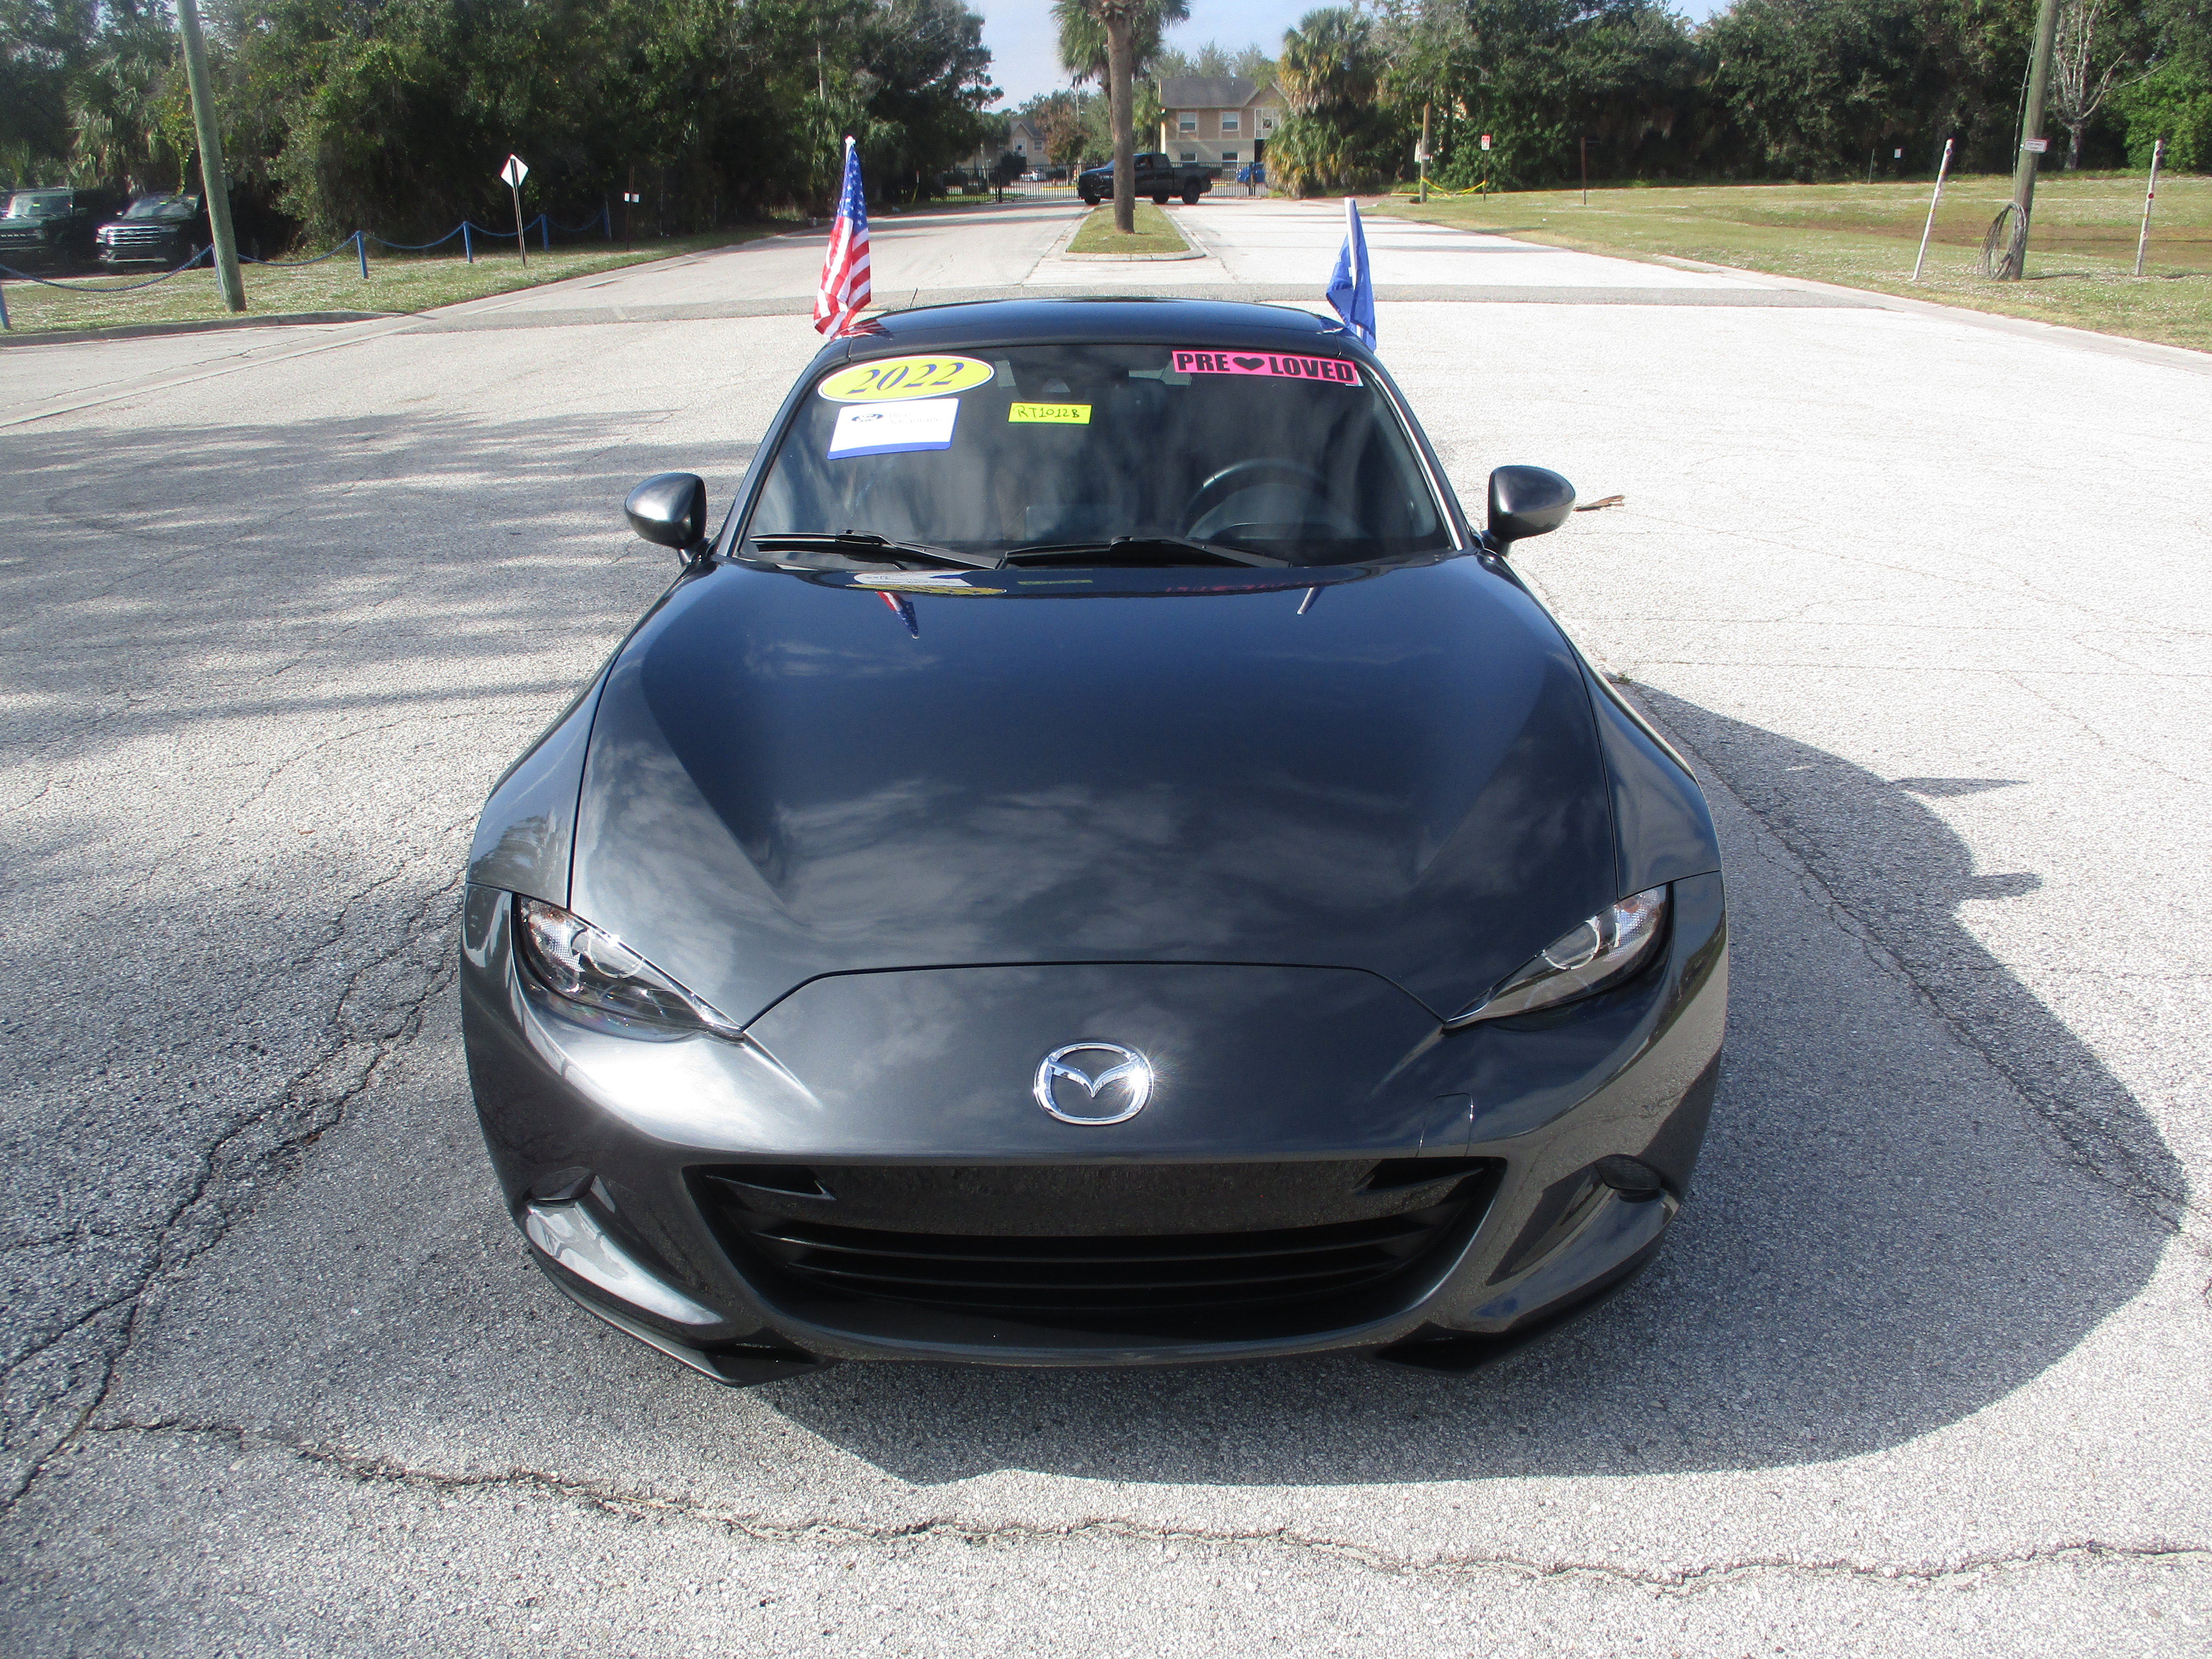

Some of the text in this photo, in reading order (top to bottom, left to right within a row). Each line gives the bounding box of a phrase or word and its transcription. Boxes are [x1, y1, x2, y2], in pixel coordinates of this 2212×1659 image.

[845, 362, 965, 395] 2022
[1176, 353, 1354, 382] PRE LOVED
